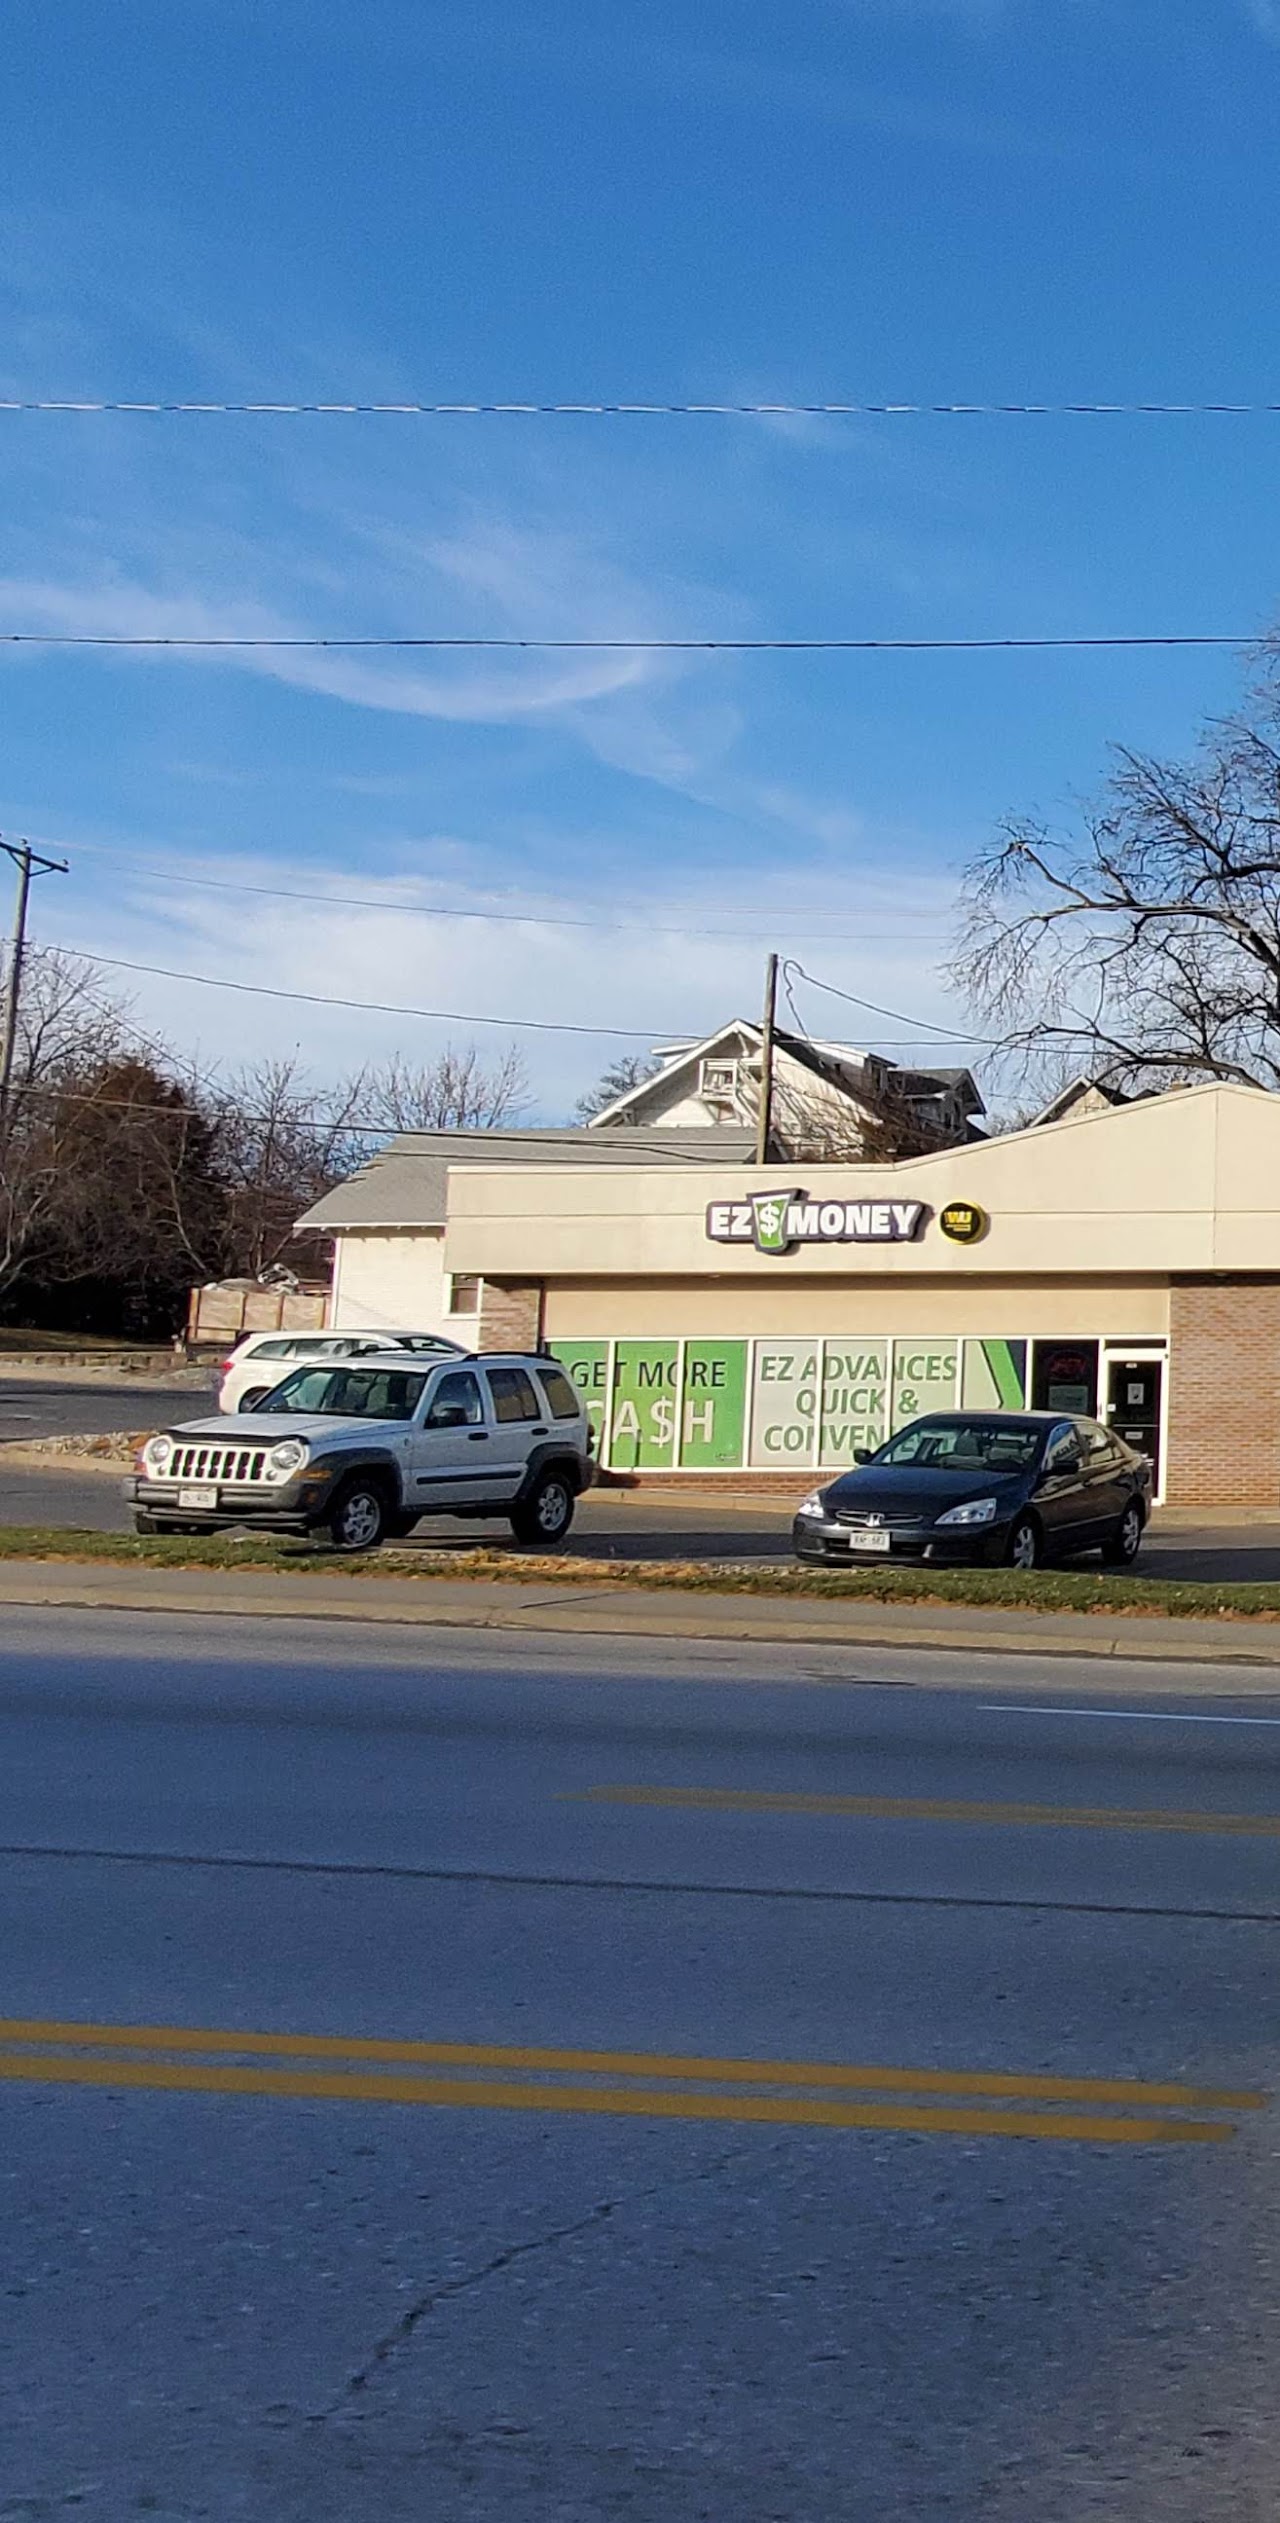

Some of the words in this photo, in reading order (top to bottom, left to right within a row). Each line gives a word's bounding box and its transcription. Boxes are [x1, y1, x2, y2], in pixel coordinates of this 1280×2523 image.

[710, 1206, 752, 1236] EZ
[786, 1204, 920, 1235] MONEY
[570, 1361, 627, 1388] GET
[638, 1361, 726, 1388] MORE
[761, 1355, 795, 1382] EZ
[799, 1355, 958, 1382] ADVANCES
[795, 1388, 887, 1419] QUICK
[897, 1388, 920, 1415] &
